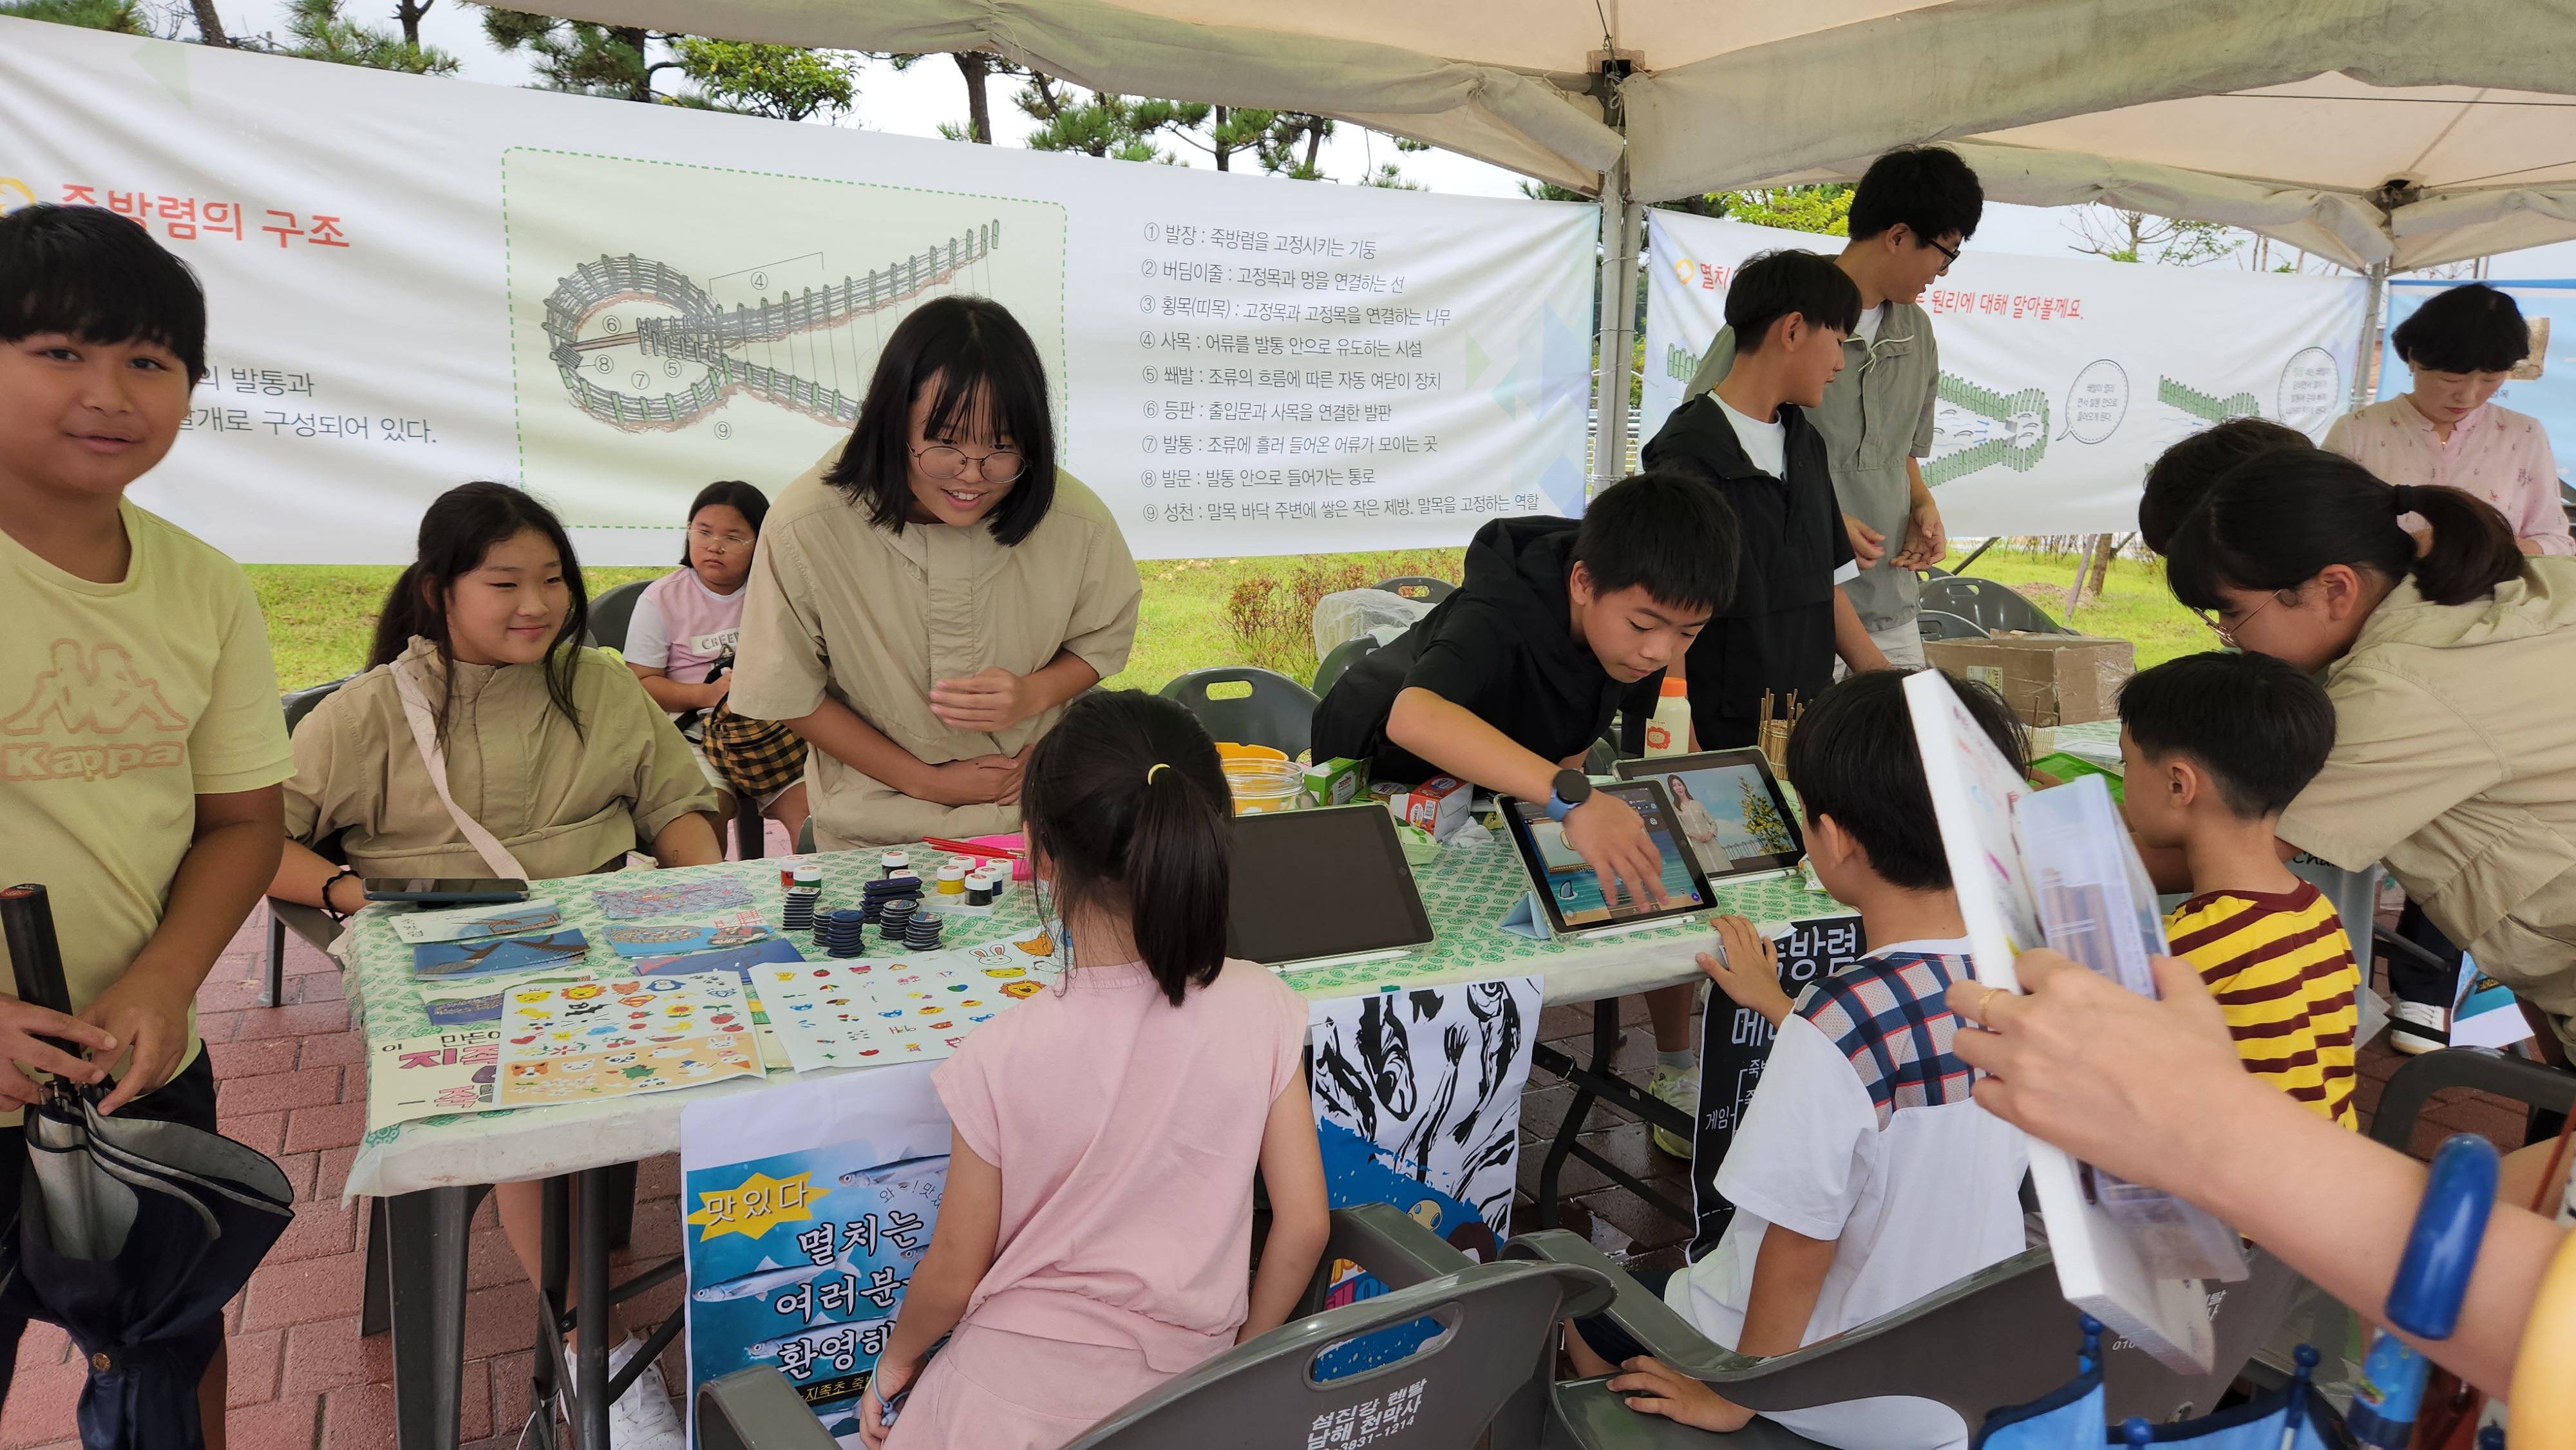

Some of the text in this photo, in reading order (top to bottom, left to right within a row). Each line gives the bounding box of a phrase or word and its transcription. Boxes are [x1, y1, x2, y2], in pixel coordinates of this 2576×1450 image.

[262, 209, 350, 248] 구조
[1166, 225, 1197, 245] 발장
[1210, 229, 1269, 251] 죽방렴을
[1274, 236, 1344, 257] 고정시키는
[1349, 240, 1376, 259] 기둥
[1237, 268, 1296, 288] 고정목과
[1302, 271, 1329, 290] 멍을
[1335, 273, 1386, 292] 연결하는
[1391, 276, 1405, 293] 선
[1700, 263, 1740, 290] 멸치
[1243, 303, 1300, 322] 고정목과
[1305, 306, 1361, 324] 고정목을
[1367, 308, 1421, 325] 연결하는
[1426, 309, 1450, 326] 나무
[1932, 290, 1976, 314] 원리에
[1980, 294, 2009, 315] 대해
[1161, 332, 1191, 351] 사목
[1206, 334, 1249, 353] 어류를
[1255, 336, 1284, 355] 발통
[1289, 337, 1331, 355] 안으로
[1336, 339, 1390, 357] 유도하는
[1396, 340, 1422, 357] 시설
[232, 368, 314, 397] 발통과
[1209, 368, 1253, 387] 조류의
[1258, 370, 1300, 388] 흐름에
[1306, 370, 1334, 388] 따른
[1339, 372, 1365, 389] 자동
[1372, 372, 1410, 390] 여닫이
[1416, 372, 1440, 390] 장치
[1164, 400, 1195, 420] 등판
[1209, 401, 1267, 421] 출입문과
[1271, 403, 1313, 421] 사목을
[1320, 404, 1359, 421] 연결한
[1365, 404, 1392, 422] 발판
[262, 411, 368, 439] 구성되어
[381, 418, 437, 444] 있다.
[1164, 435, 1193, 454] 발통
[1208, 436, 1251, 454] 조류에
[1256, 437, 1284, 454] 흘러
[1290, 437, 1329, 454] 들어온
[1335, 436, 1374, 453] 어류가
[1379, 435, 1419, 452] 모이는
[1424, 435, 1437, 452] 곳
[1162, 469, 1191, 487] 발문
[1207, 469, 1235, 487] 발통
[1240, 469, 1283, 487] 안으로
[1287, 469, 1343, 486] 들어가는
[1349, 469, 1376, 485] 통로
[1164, 504, 1194, 522] 성천
[1208, 503, 1236, 520] 말목
[1242, 502, 1269, 520] 바닥
[1275, 501, 1316, 519] 주변에
[1321, 500, 1348, 518] 쌓은
[1353, 500, 1379, 516] 작은
[1418, 496, 1456, 514] 말목을
[1461, 495, 1510, 513] 고정하는
[1515, 493, 1539, 510] 역할
[0, 740, 185, 781] Kappa
[1705, 1105, 1730, 1131] 게임
[706, 1180, 808, 1227] 맛있다
[798, 1211, 924, 1266] 멸치는
[775, 1267, 911, 1324] 여러분
[1312, 1378, 1427, 1431] 섬진강 렌탈
[1307, 1393, 1422, 1450] 남해 천막사
